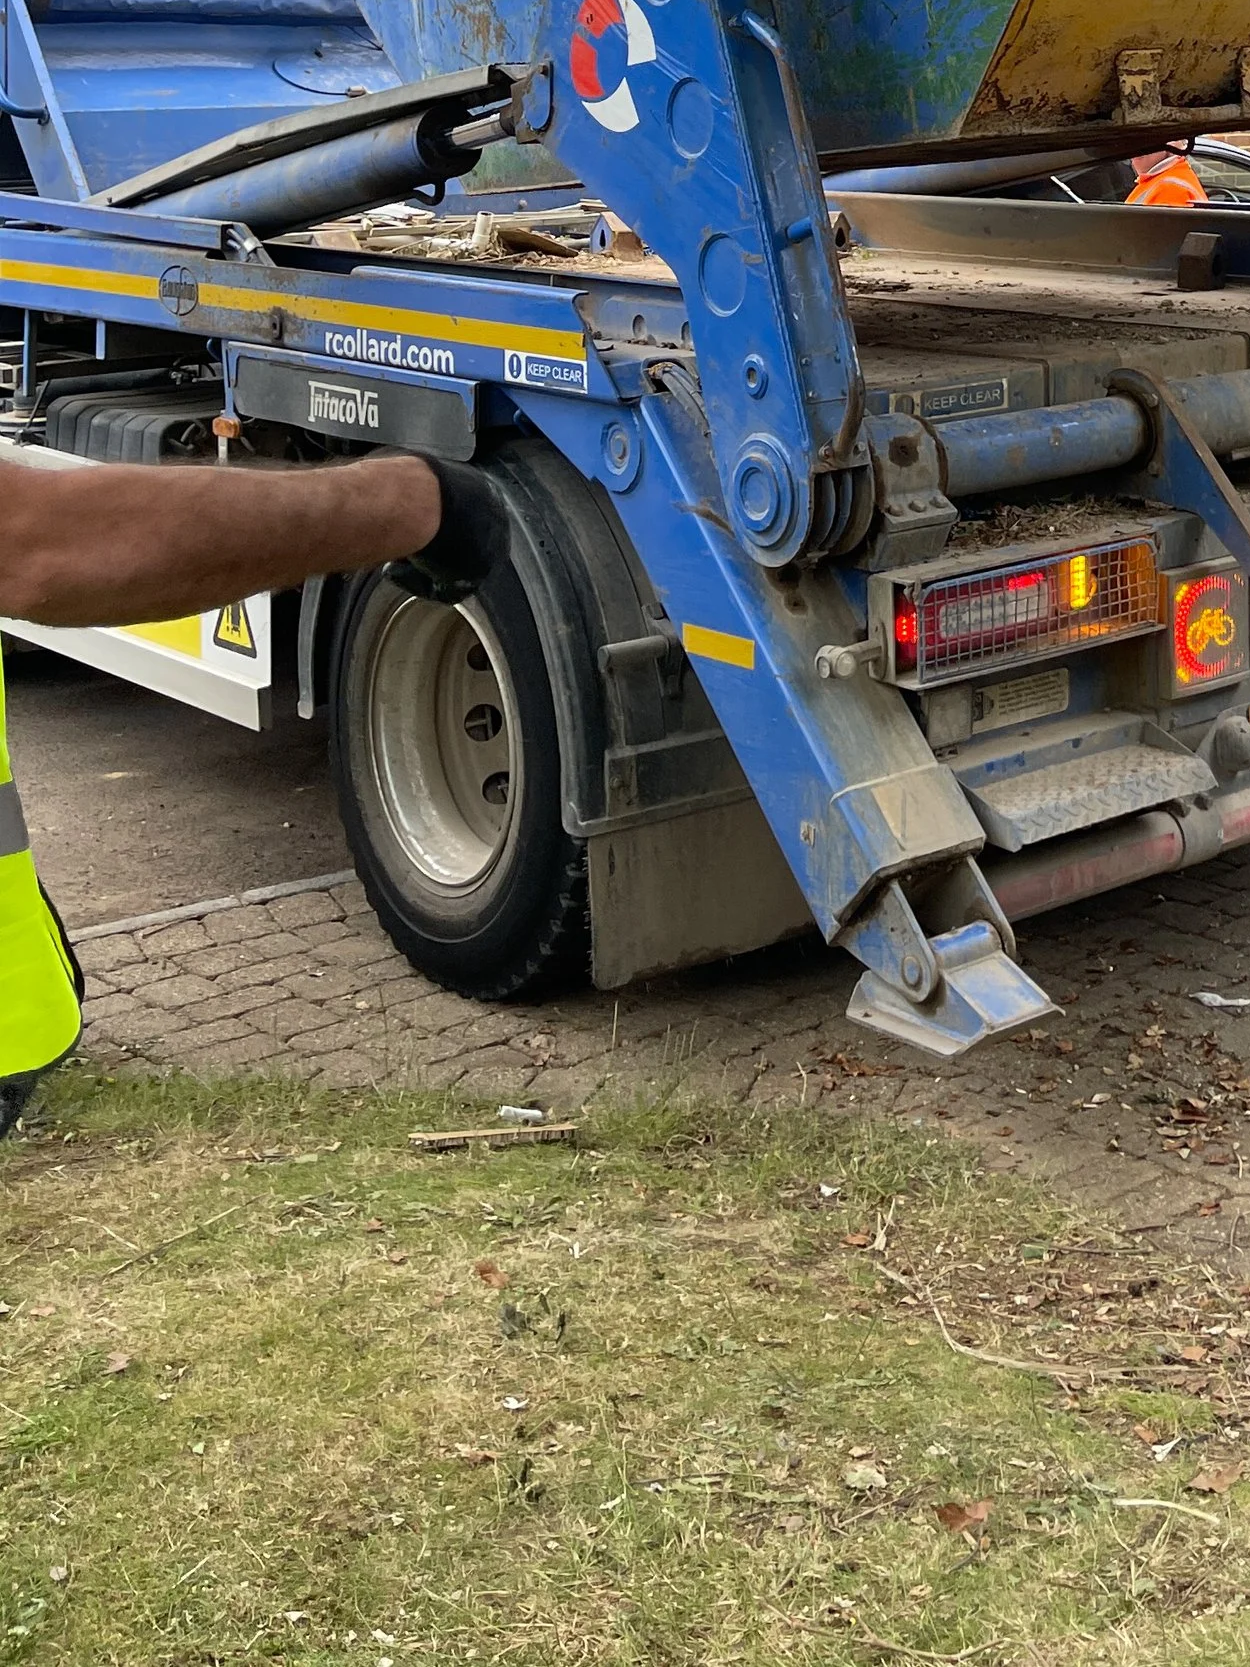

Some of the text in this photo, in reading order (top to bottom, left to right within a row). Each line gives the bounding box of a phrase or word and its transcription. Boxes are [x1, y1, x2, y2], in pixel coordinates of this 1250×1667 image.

[324, 328, 455, 374] rcollard.com
[527, 362, 582, 382] KEEP CLEAR
[924, 388, 1001, 410] KEEP CLEAR
